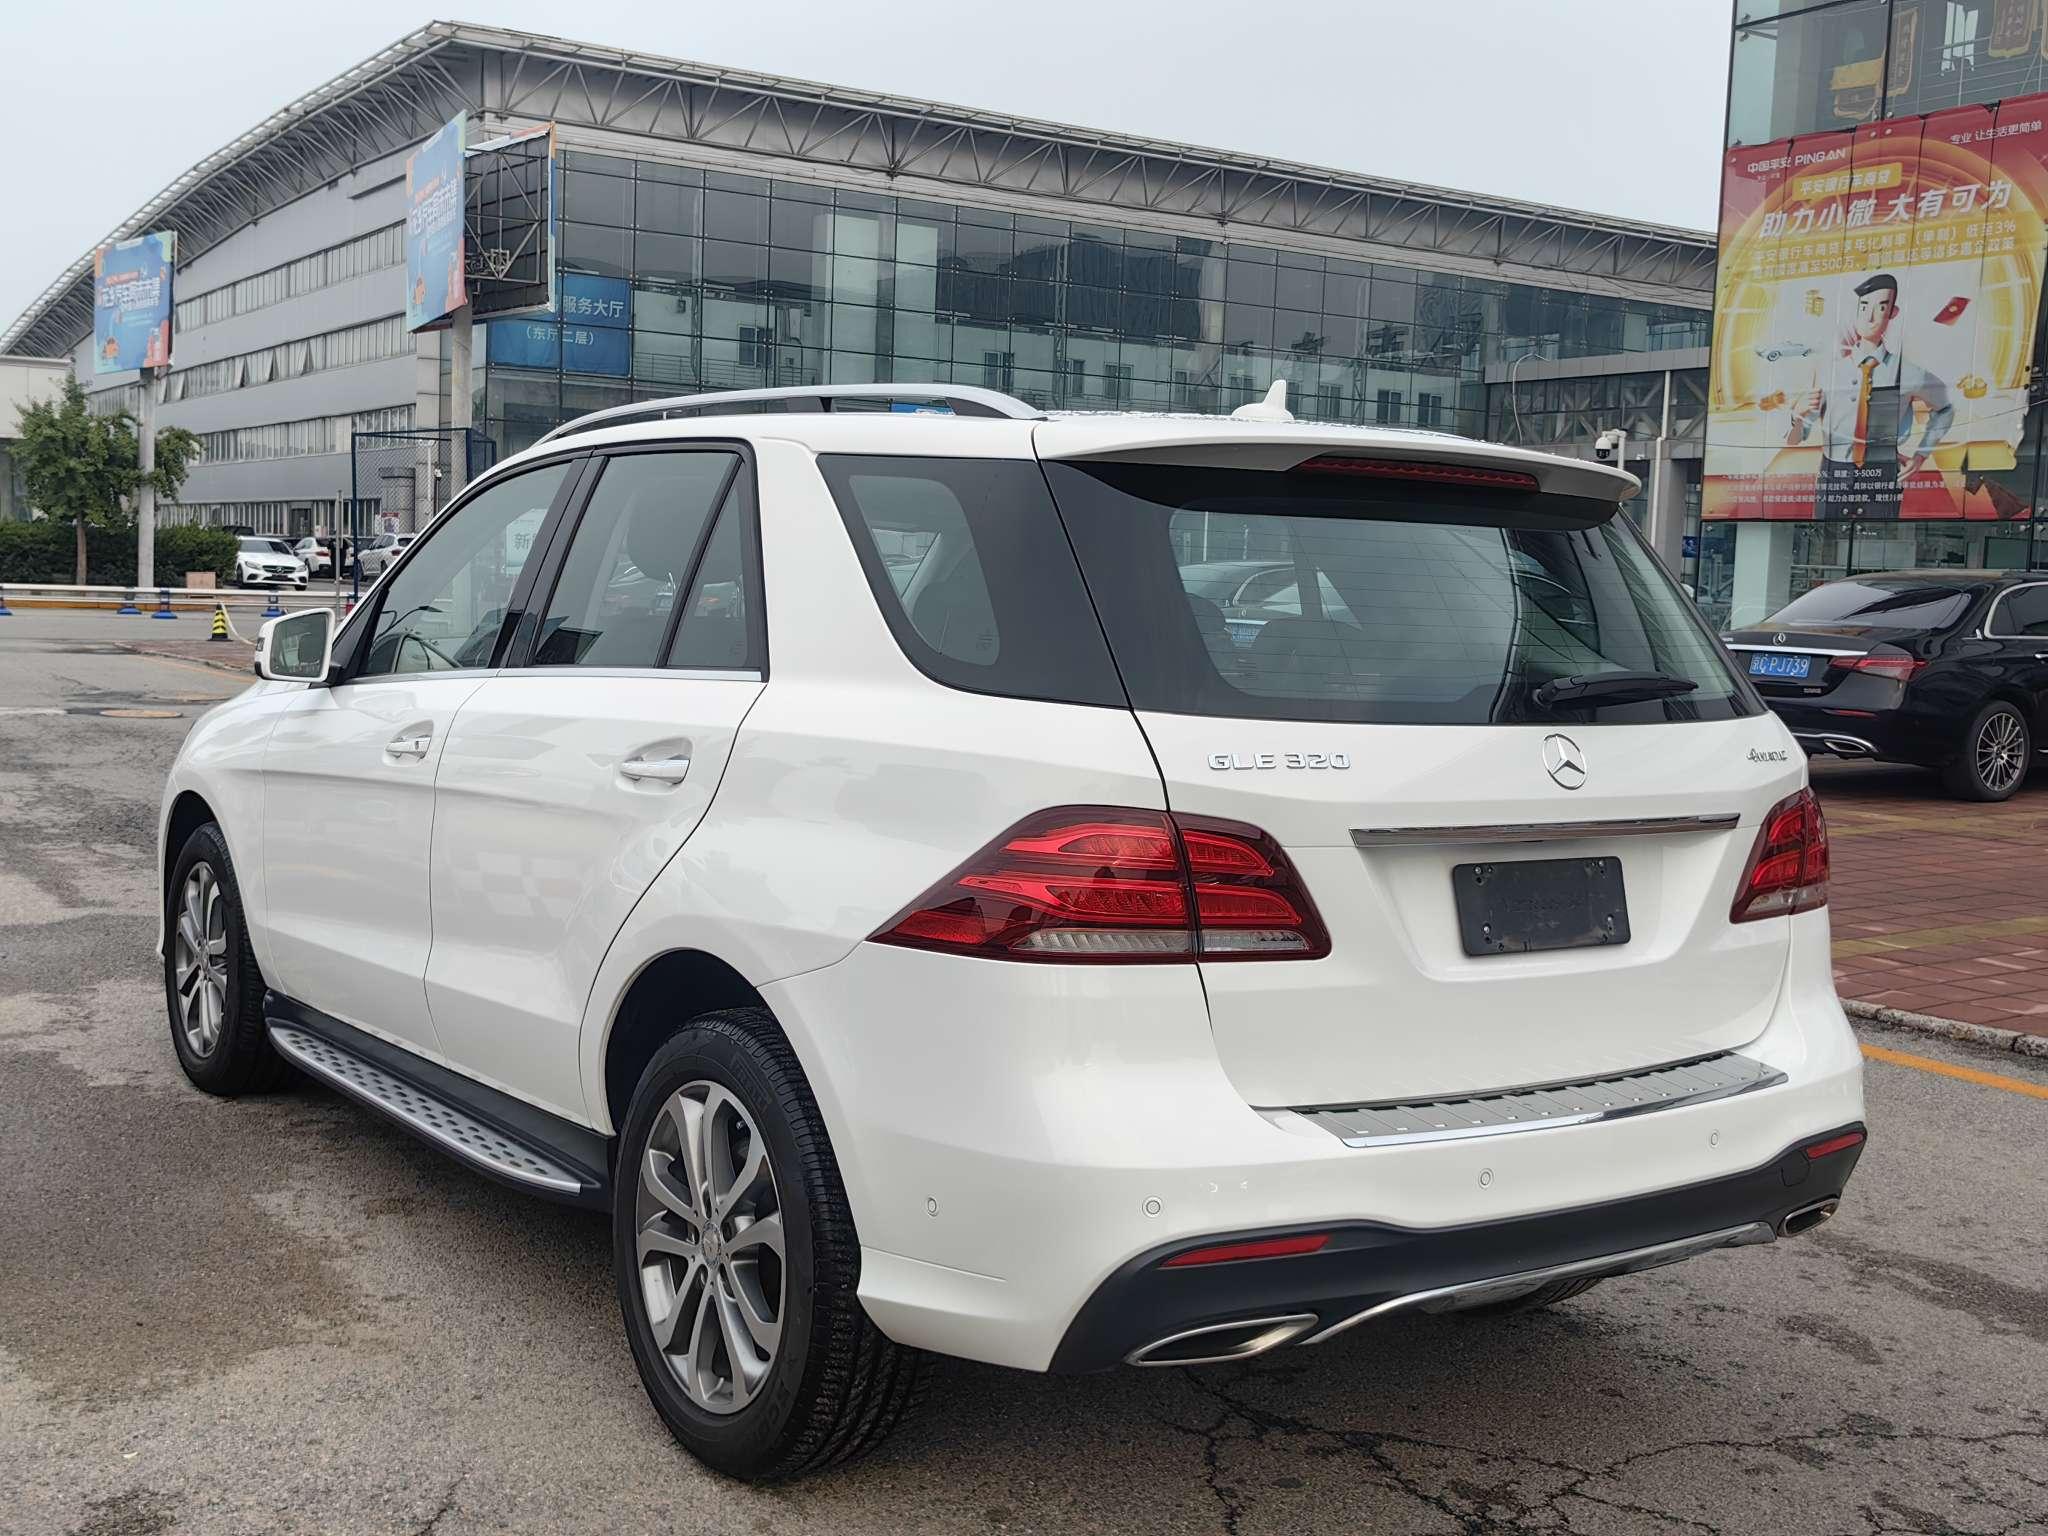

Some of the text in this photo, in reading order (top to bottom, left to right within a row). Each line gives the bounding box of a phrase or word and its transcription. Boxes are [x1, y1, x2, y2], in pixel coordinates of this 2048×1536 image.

[1747, 148, 1847, 174] 中国平安 PINGAN
[1759, 180, 2013, 239] 助力小微 大有可为
[556, 295, 625, 318] 服务大厅
[1207, 751, 1351, 770] GLE 320
